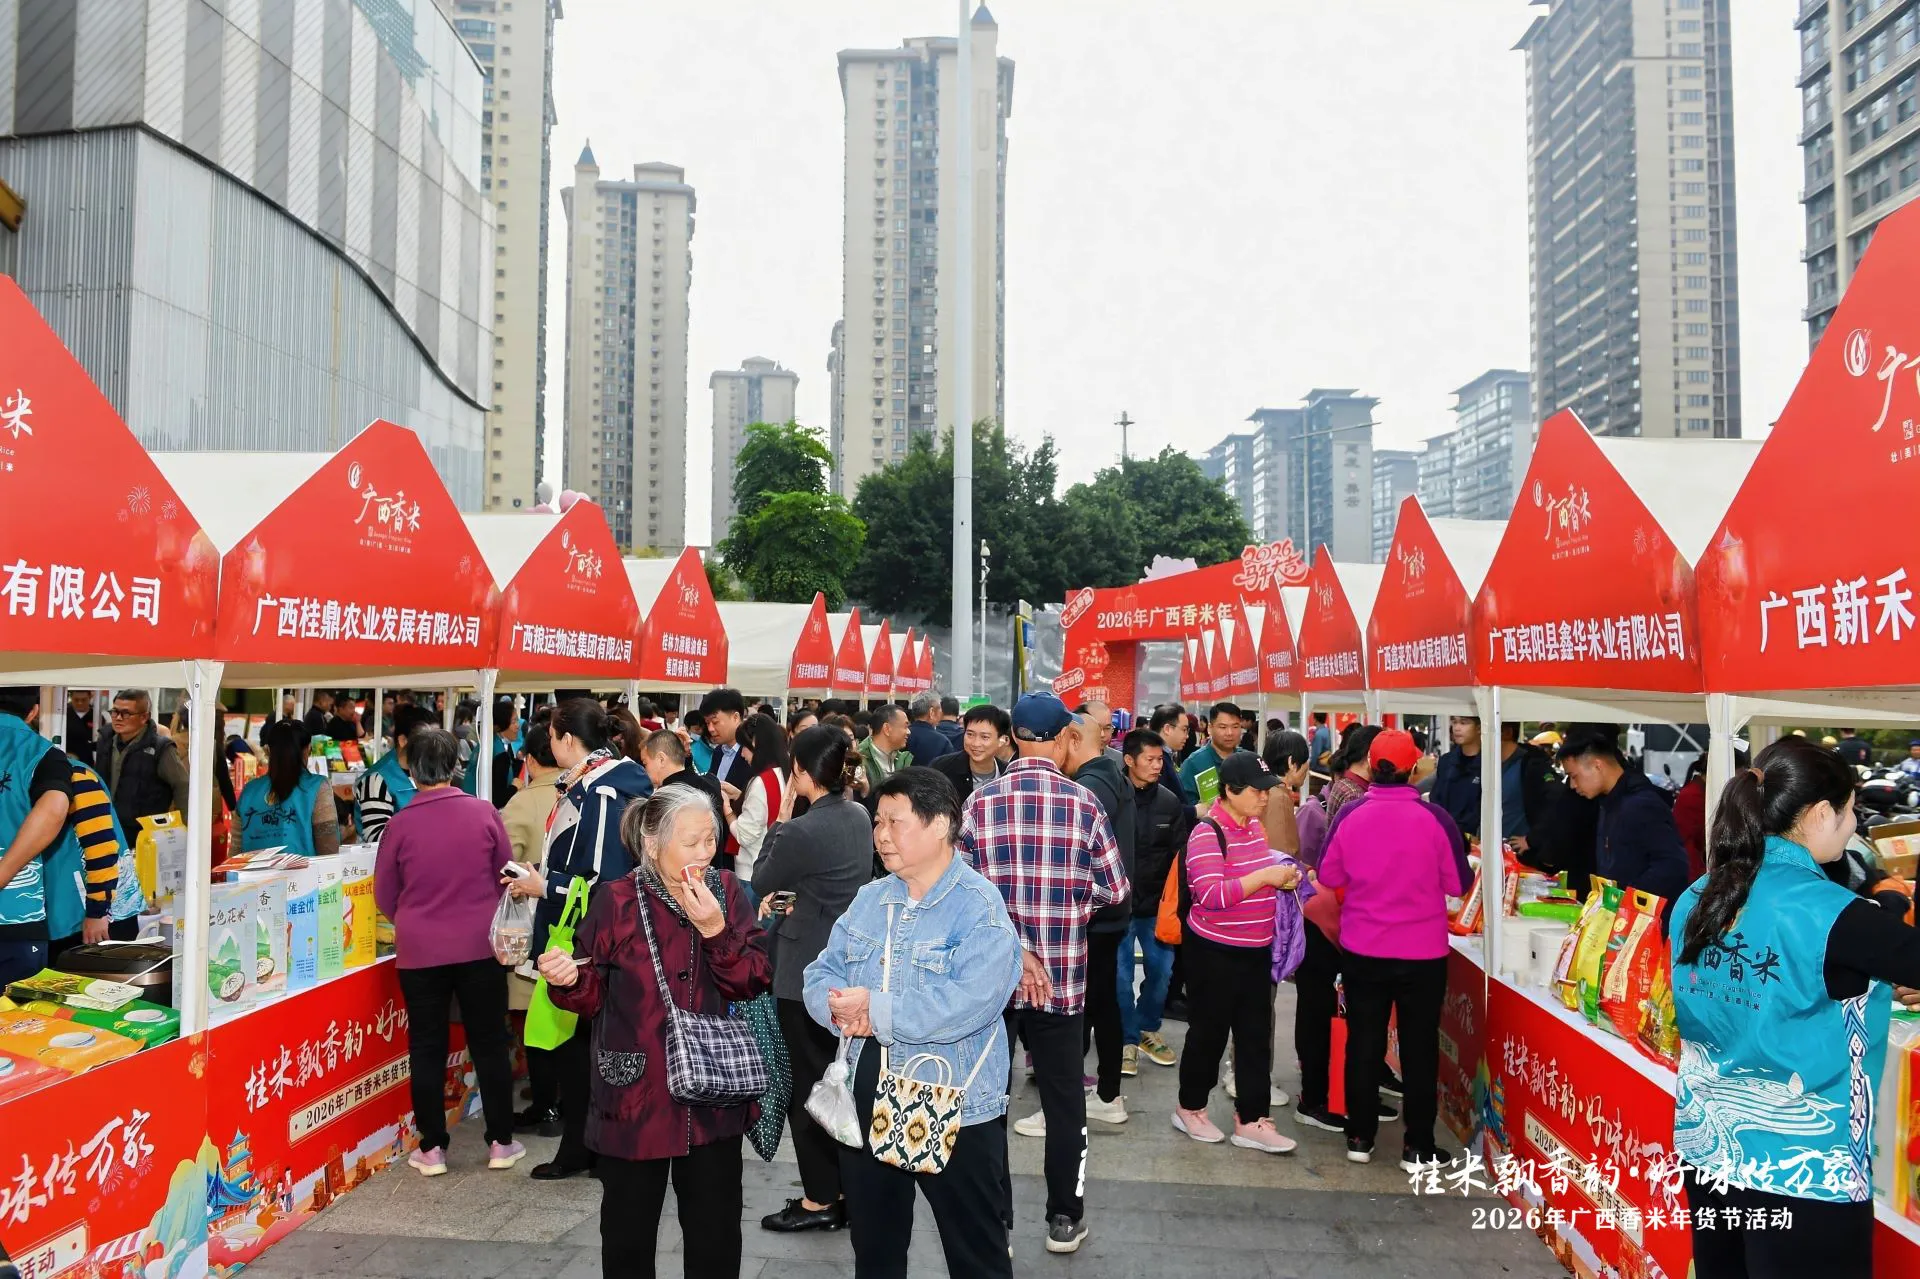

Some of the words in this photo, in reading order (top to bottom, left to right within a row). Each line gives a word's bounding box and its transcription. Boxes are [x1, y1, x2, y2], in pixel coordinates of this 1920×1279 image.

[1871, 345, 1920, 432] 广
[354, 482, 421, 533] 广西香米
[1544, 483, 1593, 541] 广西香米
[564, 544, 602, 579] 广西香米
[1243, 539, 1292, 565] 2026
[1, 558, 162, 626] 有限公司
[1097, 600, 1267, 629] 2026年广西香米年
[1759, 567, 1916, 653] 广西新禾
[252, 592, 481, 649] 广西桂鼎农业发展有限公司
[510, 621, 632, 664] 广西粮运物流集团有限公司
[1489, 611, 1686, 664] 广西宾阳县鑫华米业有限公司
[665, 656, 701, 679] 集团有限公司
[345, 881, 373, 897] 认准金优
[0, 1108, 156, 1230] 味传万家
[20, 1247, 56, 1279] 活动
